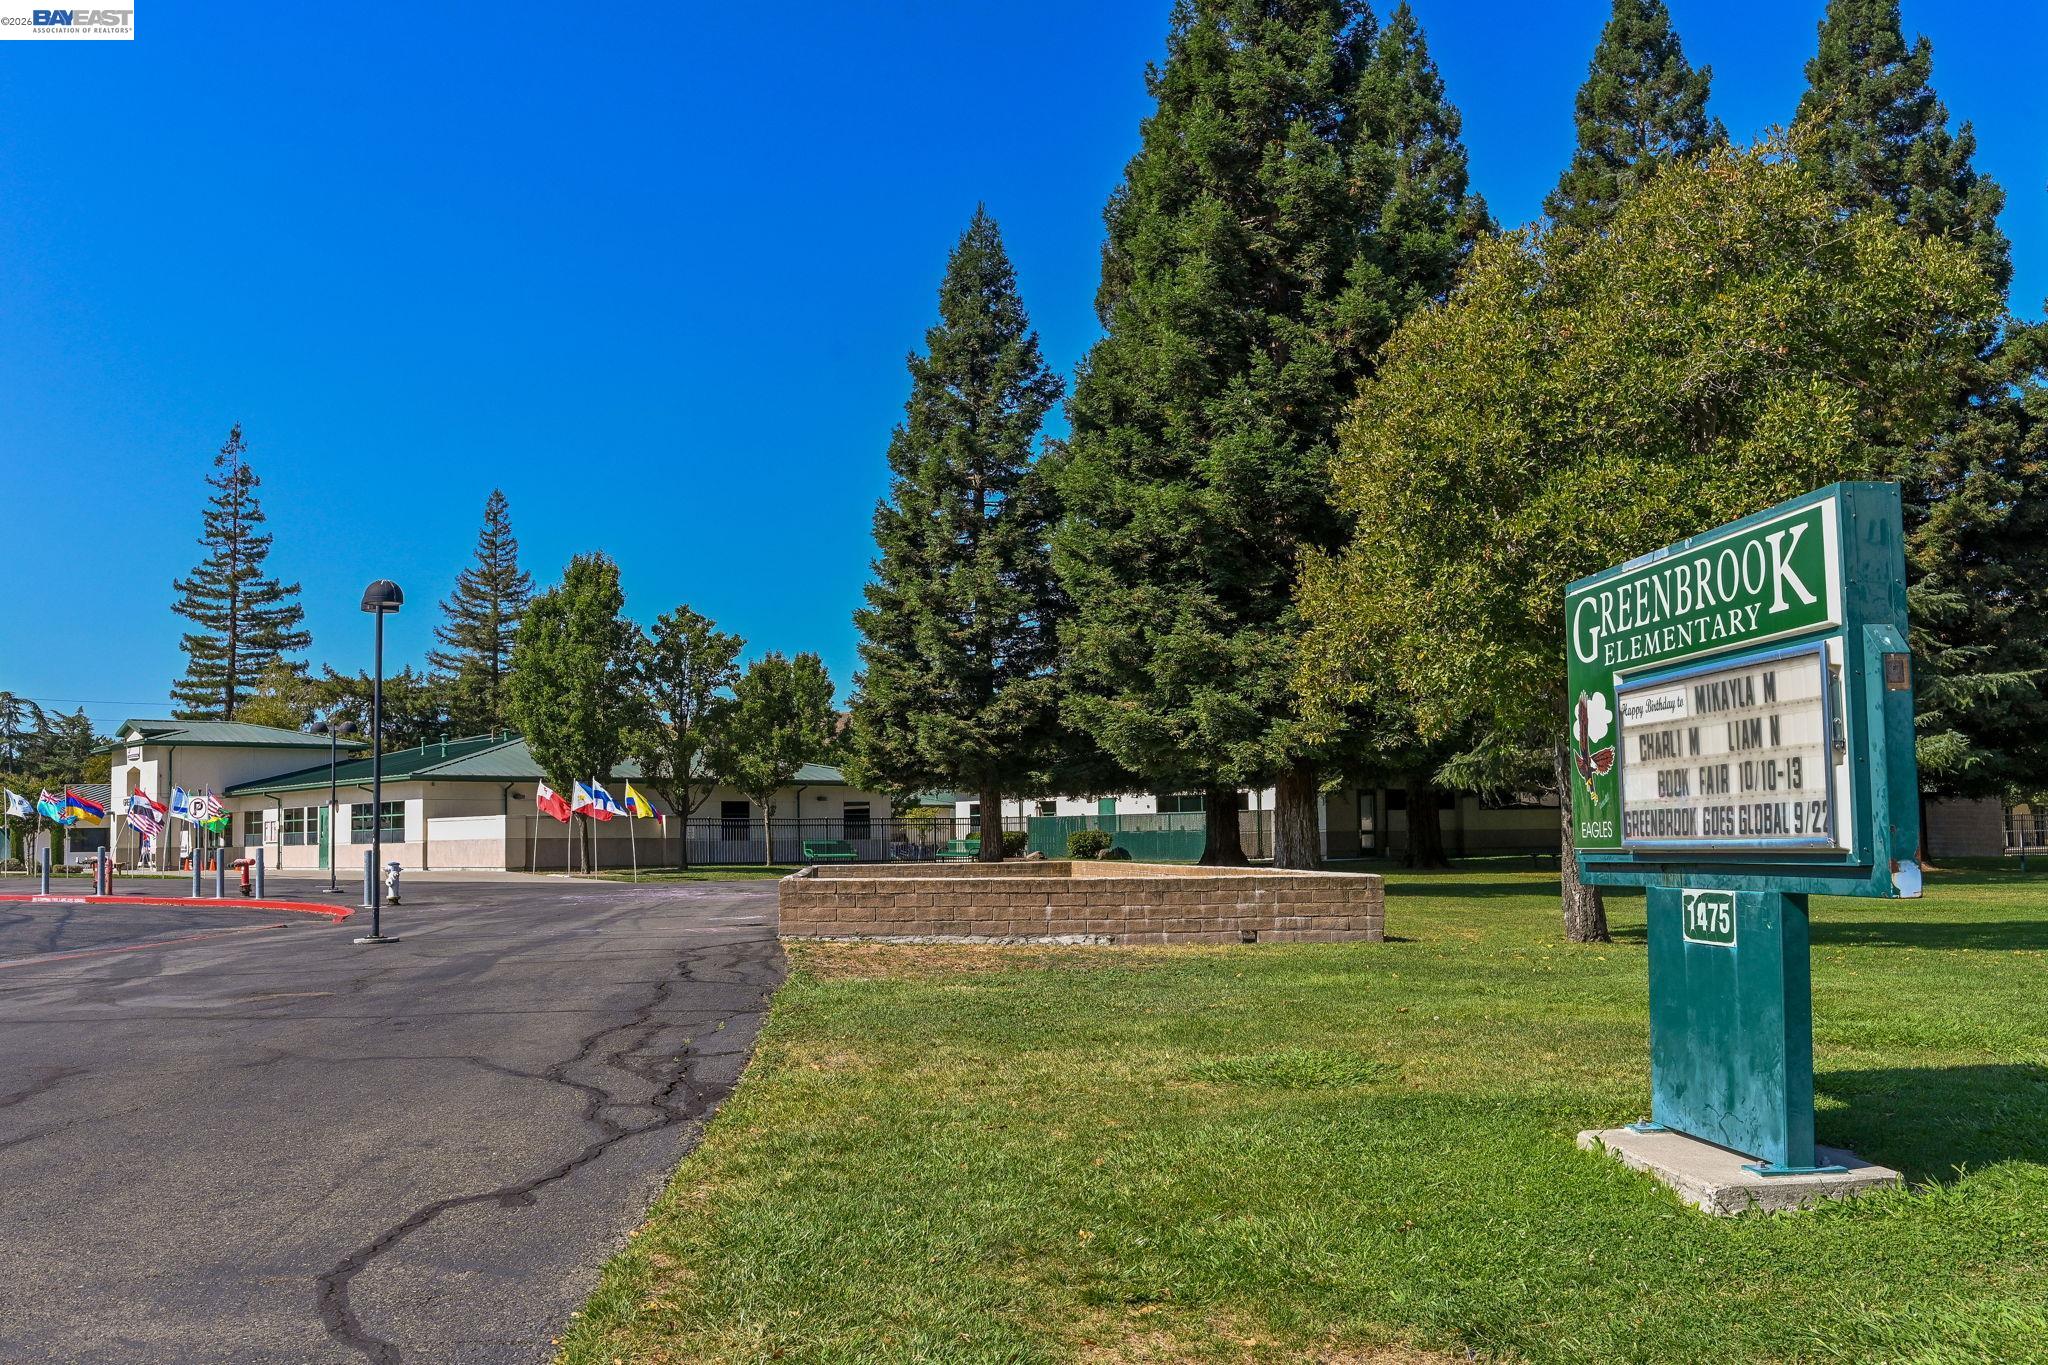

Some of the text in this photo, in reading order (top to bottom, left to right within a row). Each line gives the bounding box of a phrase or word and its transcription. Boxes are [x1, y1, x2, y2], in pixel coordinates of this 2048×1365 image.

[1573, 522, 1817, 664] GREENBROOK
[1604, 603, 1761, 666] ELEMENTARY
[1622, 696, 1684, 719] Happy Birthday to
[1695, 671, 1776, 714] MIKAYLA M
[1639, 727, 1700, 761] CHARLI M
[1728, 714, 1780, 751] LIAM N
[1658, 756, 1801, 798] BOOK FAIR 10/10-13
[1581, 821, 1613, 839] EAGLES
[1625, 800, 1828, 838] GREENBROOK GOES GLOBAL 9/22
[1687, 902, 1730, 934] 1475
